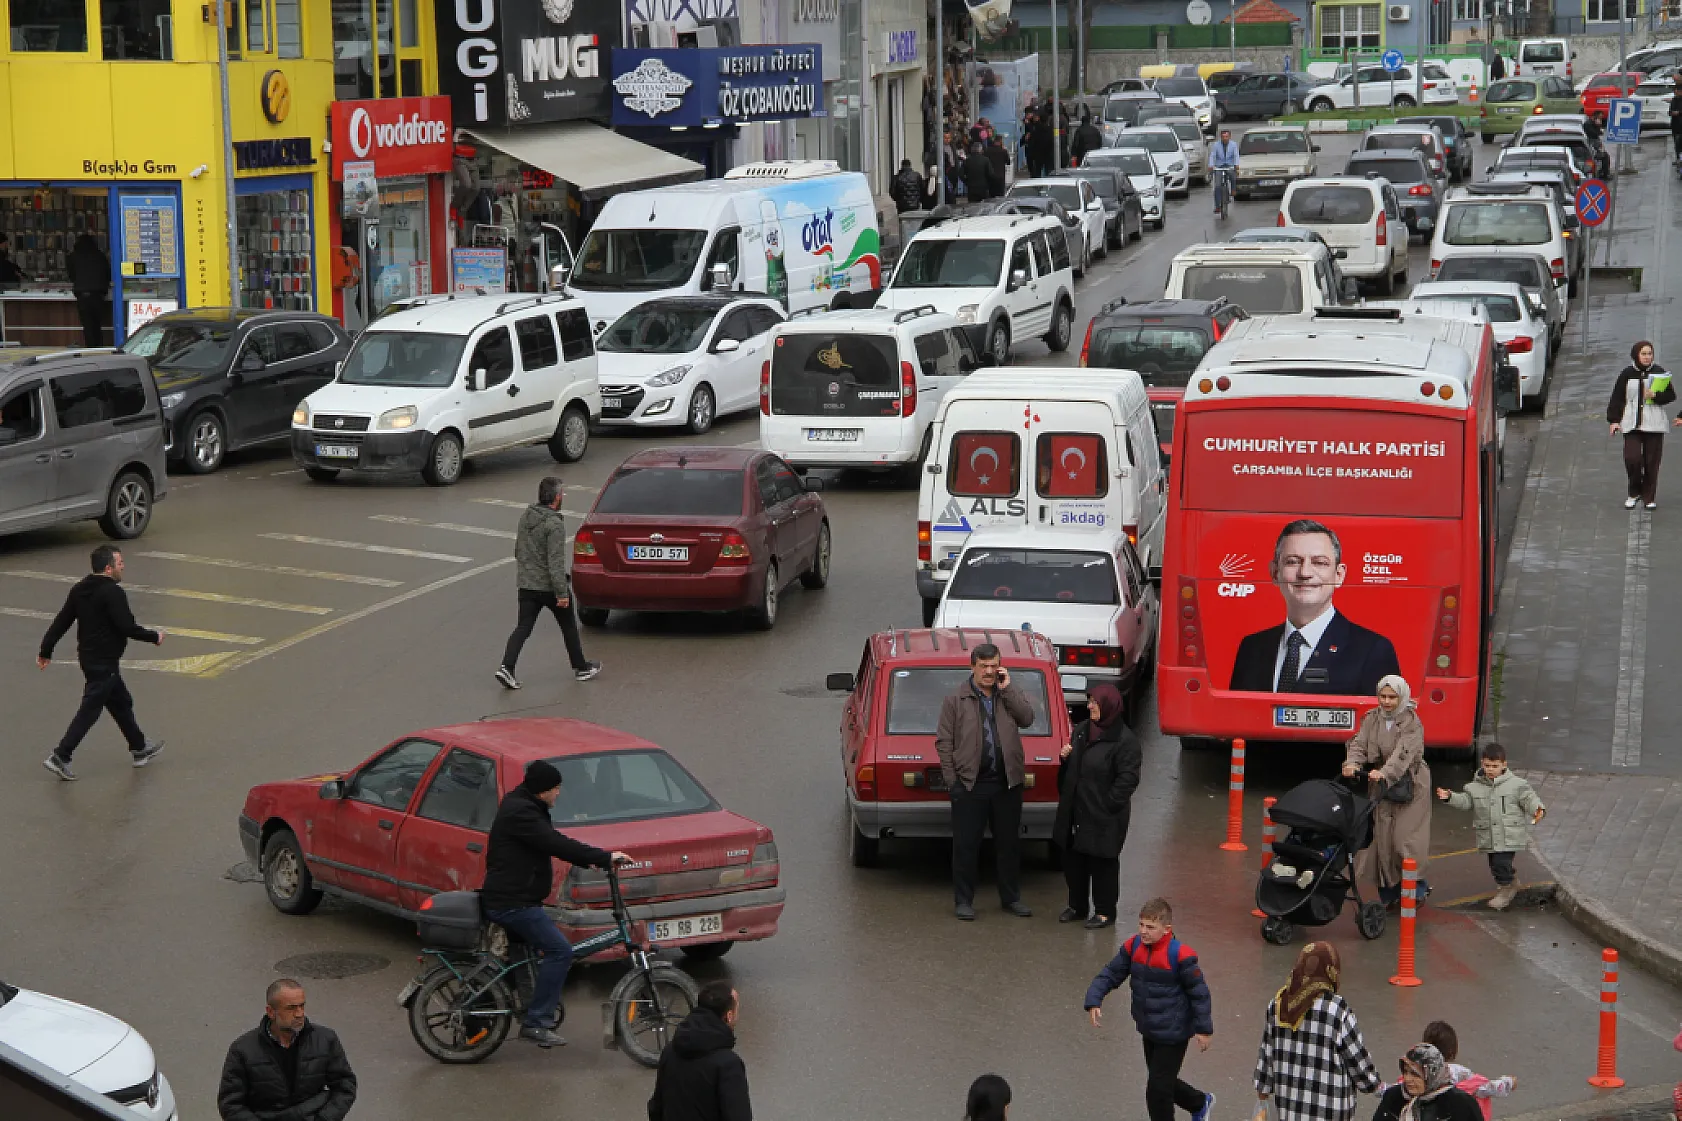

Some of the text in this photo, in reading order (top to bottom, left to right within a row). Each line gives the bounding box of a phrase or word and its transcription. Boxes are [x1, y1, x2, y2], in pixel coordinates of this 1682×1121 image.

[720, 56, 765, 77] MEŞHUR
[719, 76, 815, 121] ÖZ ÇOBANOĞLU
[1614, 102, 1636, 127] P
[375, 113, 446, 149] vodafone
[82, 159, 177, 175] B(aşk)a Gsm
[801, 206, 834, 253] otat
[1202, 436, 1446, 457] CUMHURİYET HALK PARTİSİ
[1232, 464, 1413, 480] ÇARŞAMBA İLÇE BAŞKANLIĞI
[969, 498, 1026, 517] ALS
[1060, 511, 1106, 527] akdağ
[633, 547, 646, 559] 55
[668, 548, 688, 560] 571
[1362, 552, 1403, 565] ÖZGÜR
[1362, 565, 1392, 576] ÖZEL
[1217, 582, 1256, 598] CHP
[1284, 709, 1349, 724] 55 RR 306
[656, 922, 670, 939] 55
